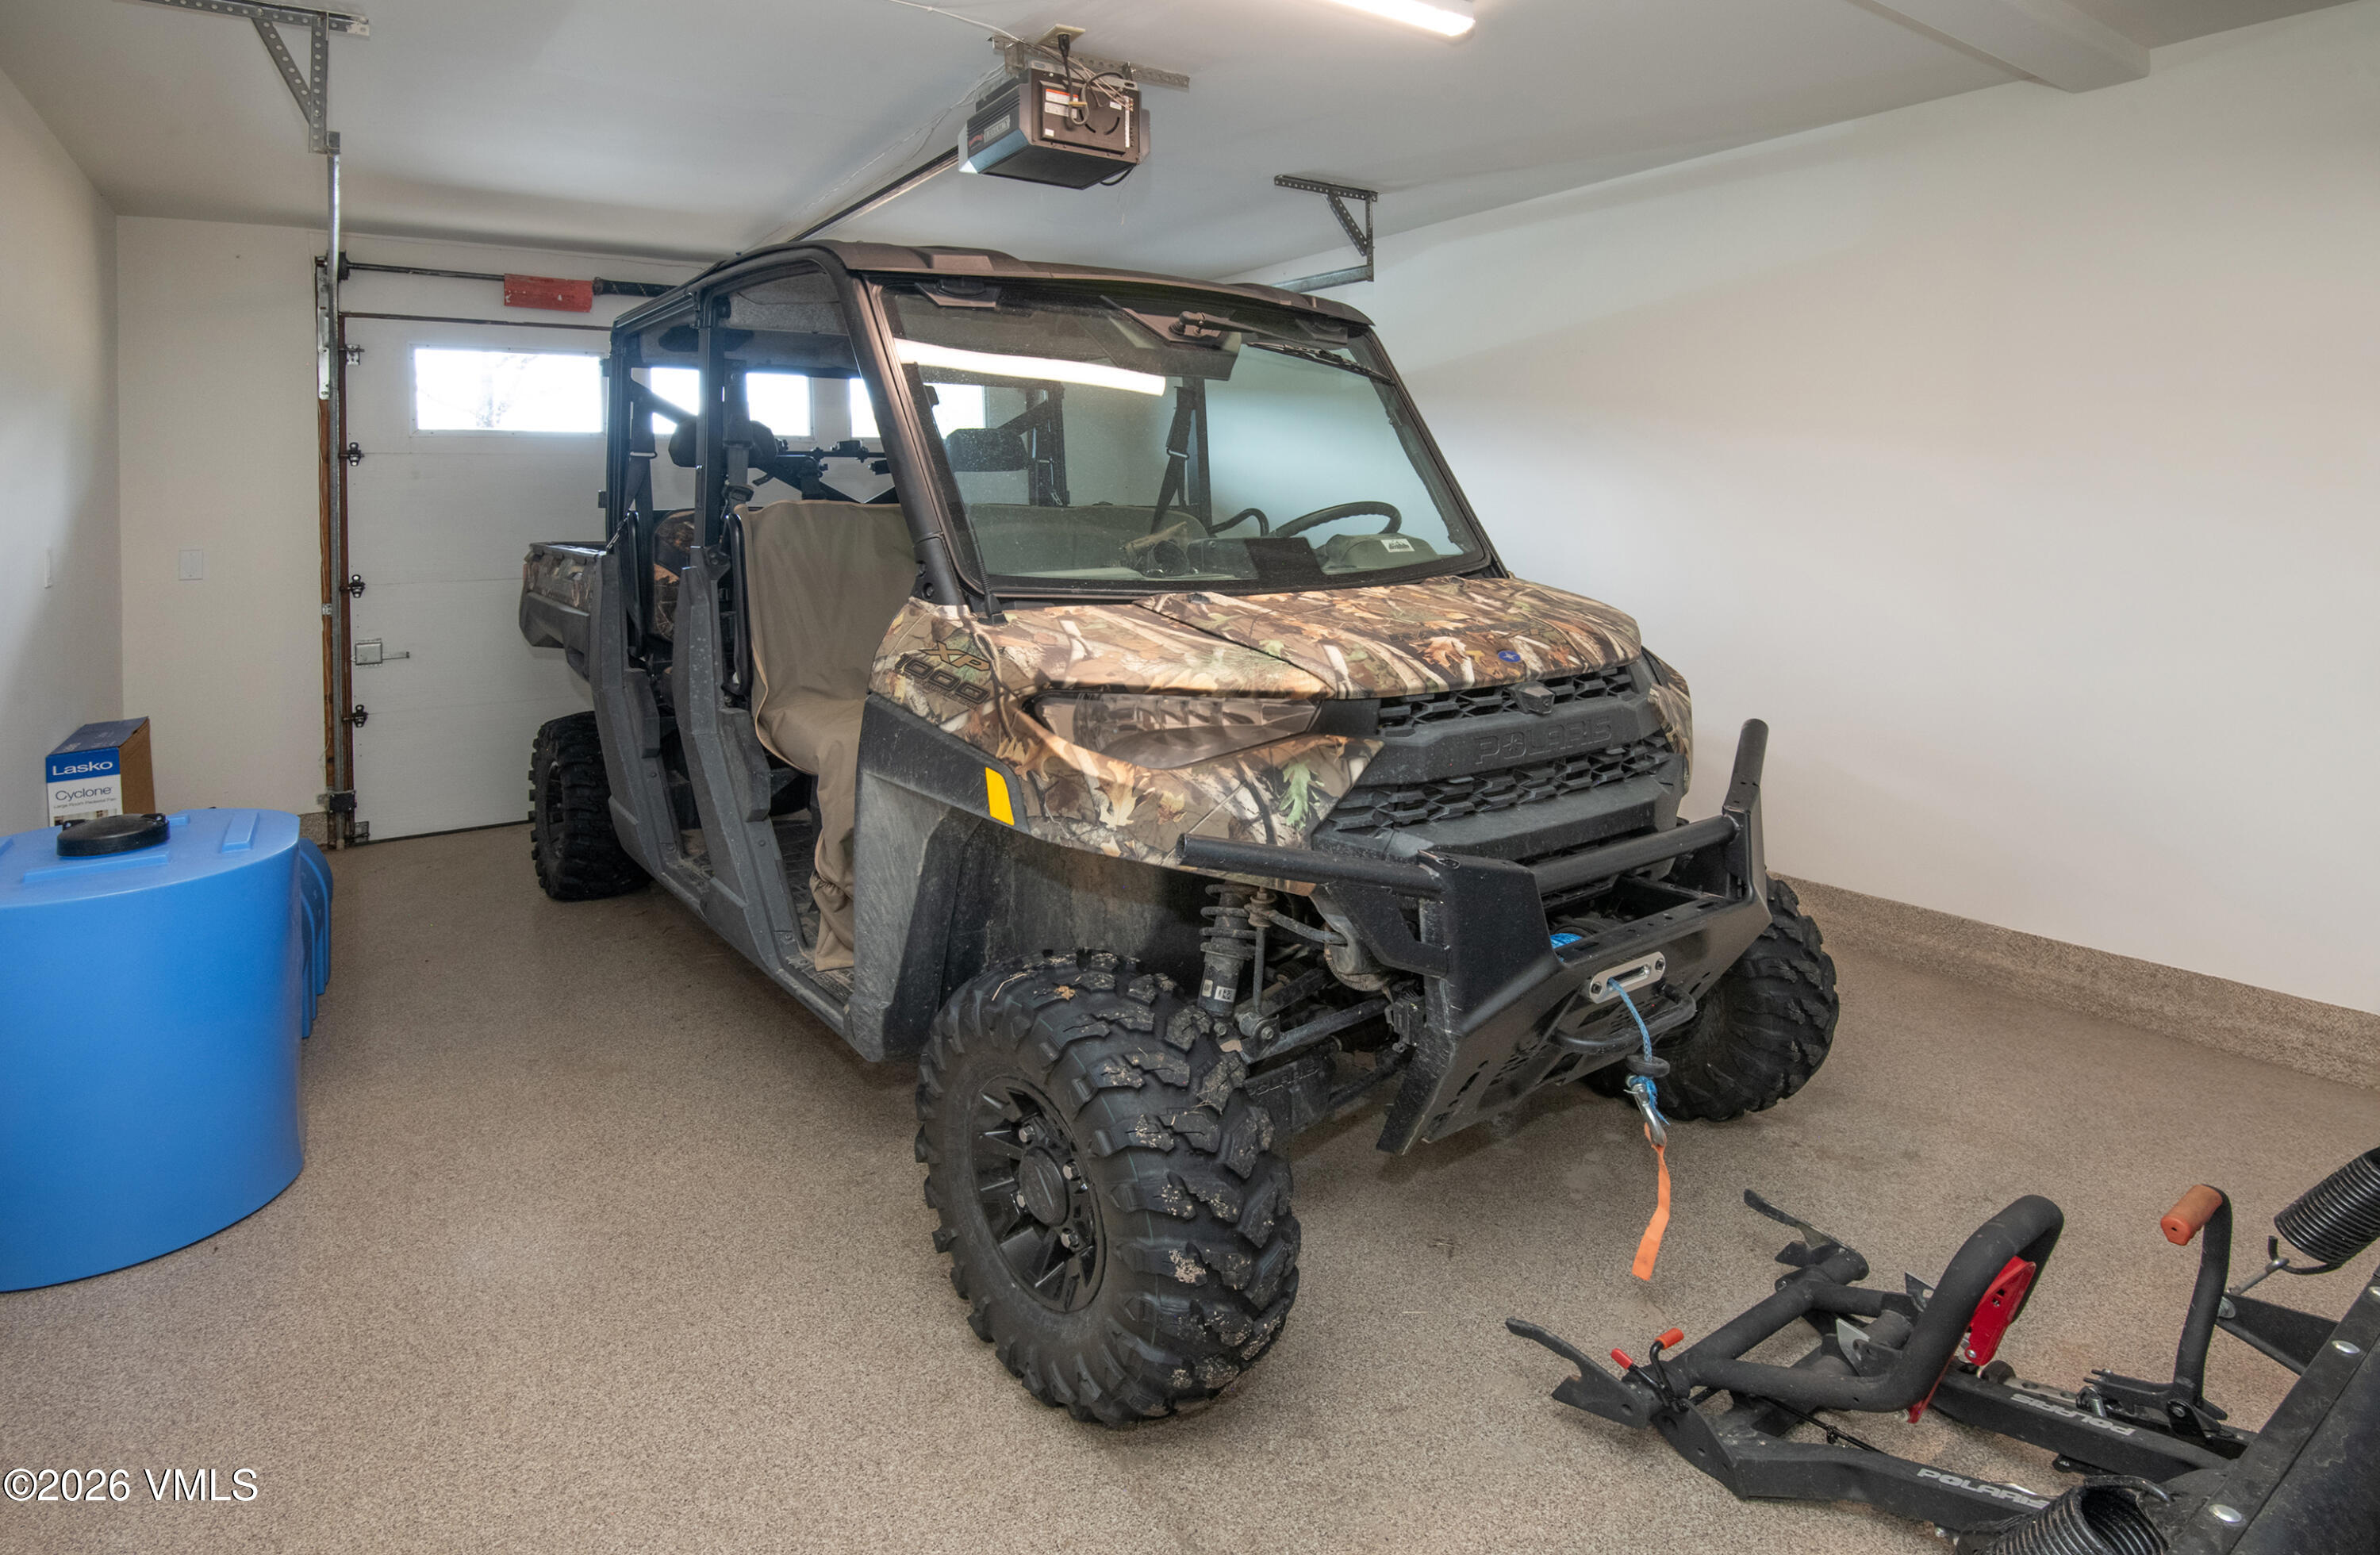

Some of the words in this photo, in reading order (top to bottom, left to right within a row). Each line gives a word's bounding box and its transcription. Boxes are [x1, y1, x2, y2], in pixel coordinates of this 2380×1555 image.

[918, 640, 991, 671] XP
[895, 652, 991, 705] 1000
[1474, 716, 1612, 765] POLARIS
[52, 761, 113, 776] Lasko
[55, 786, 112, 801] Cyclone
[2010, 1393, 2136, 1436] POLARIS
[1917, 1468, 2051, 1509] POLARIS
